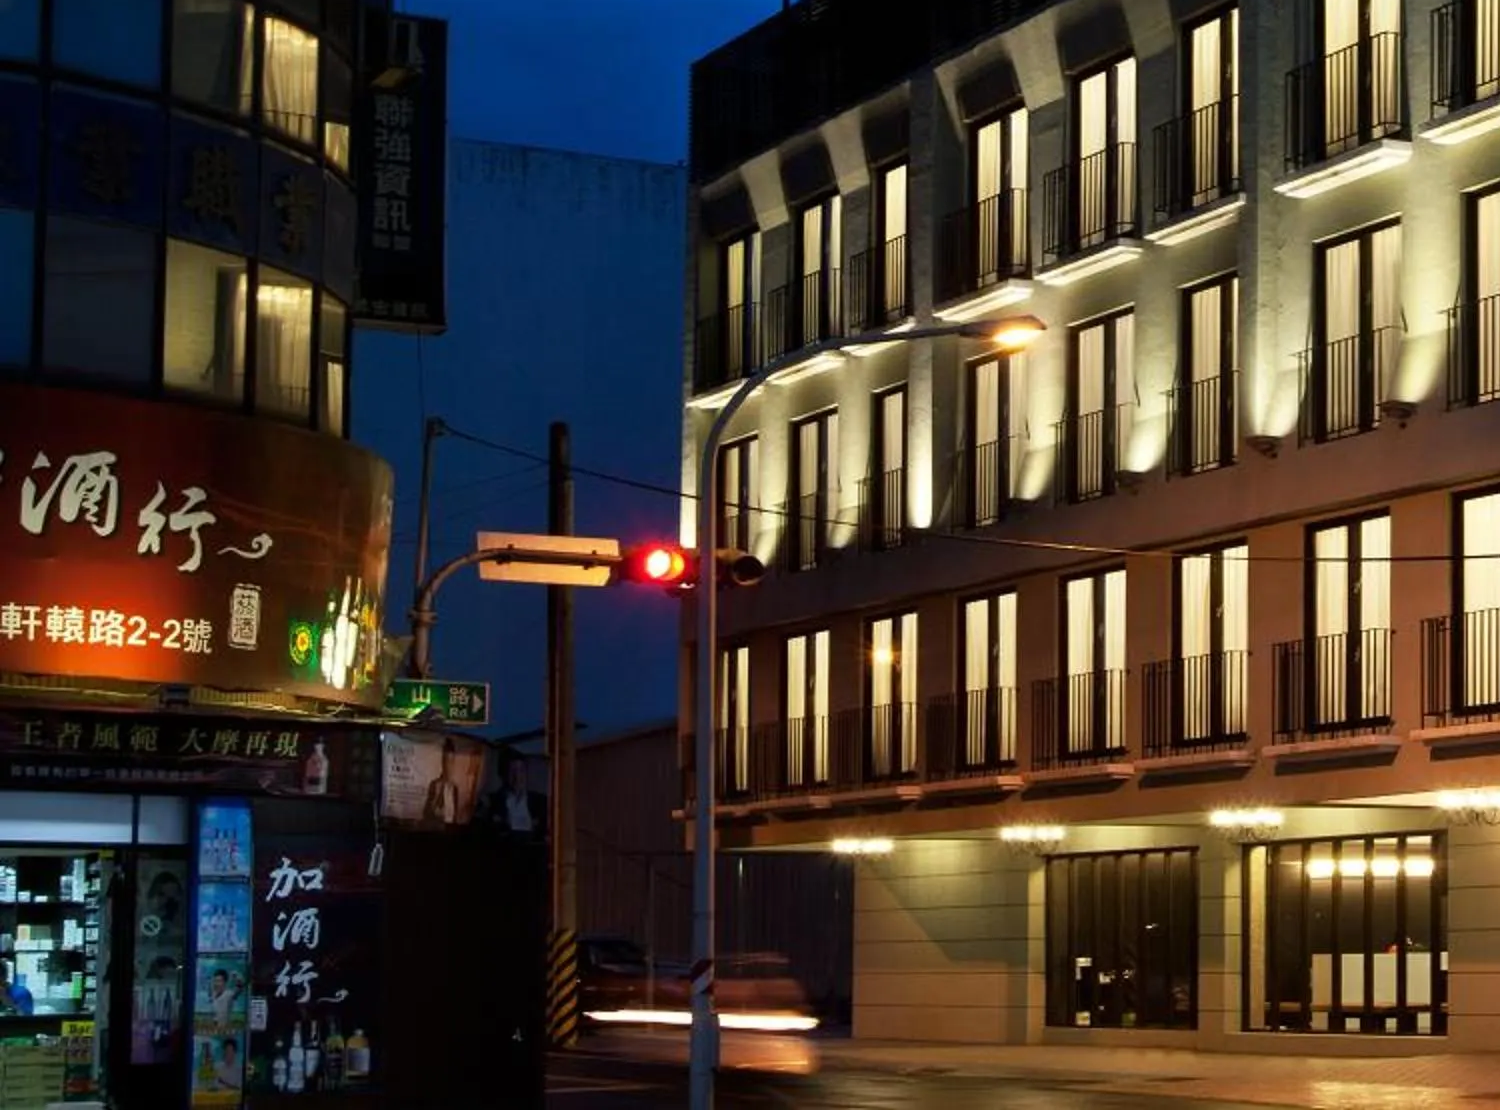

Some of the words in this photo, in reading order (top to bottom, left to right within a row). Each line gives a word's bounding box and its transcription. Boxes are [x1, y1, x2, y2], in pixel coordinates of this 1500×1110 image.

[0, 449, 217, 573] 酒行
[0, 602, 213, 655] 軒轅路2-2號
[20, 718, 160, 752] 王者風範
[266, 855, 324, 1004] 加酒行
